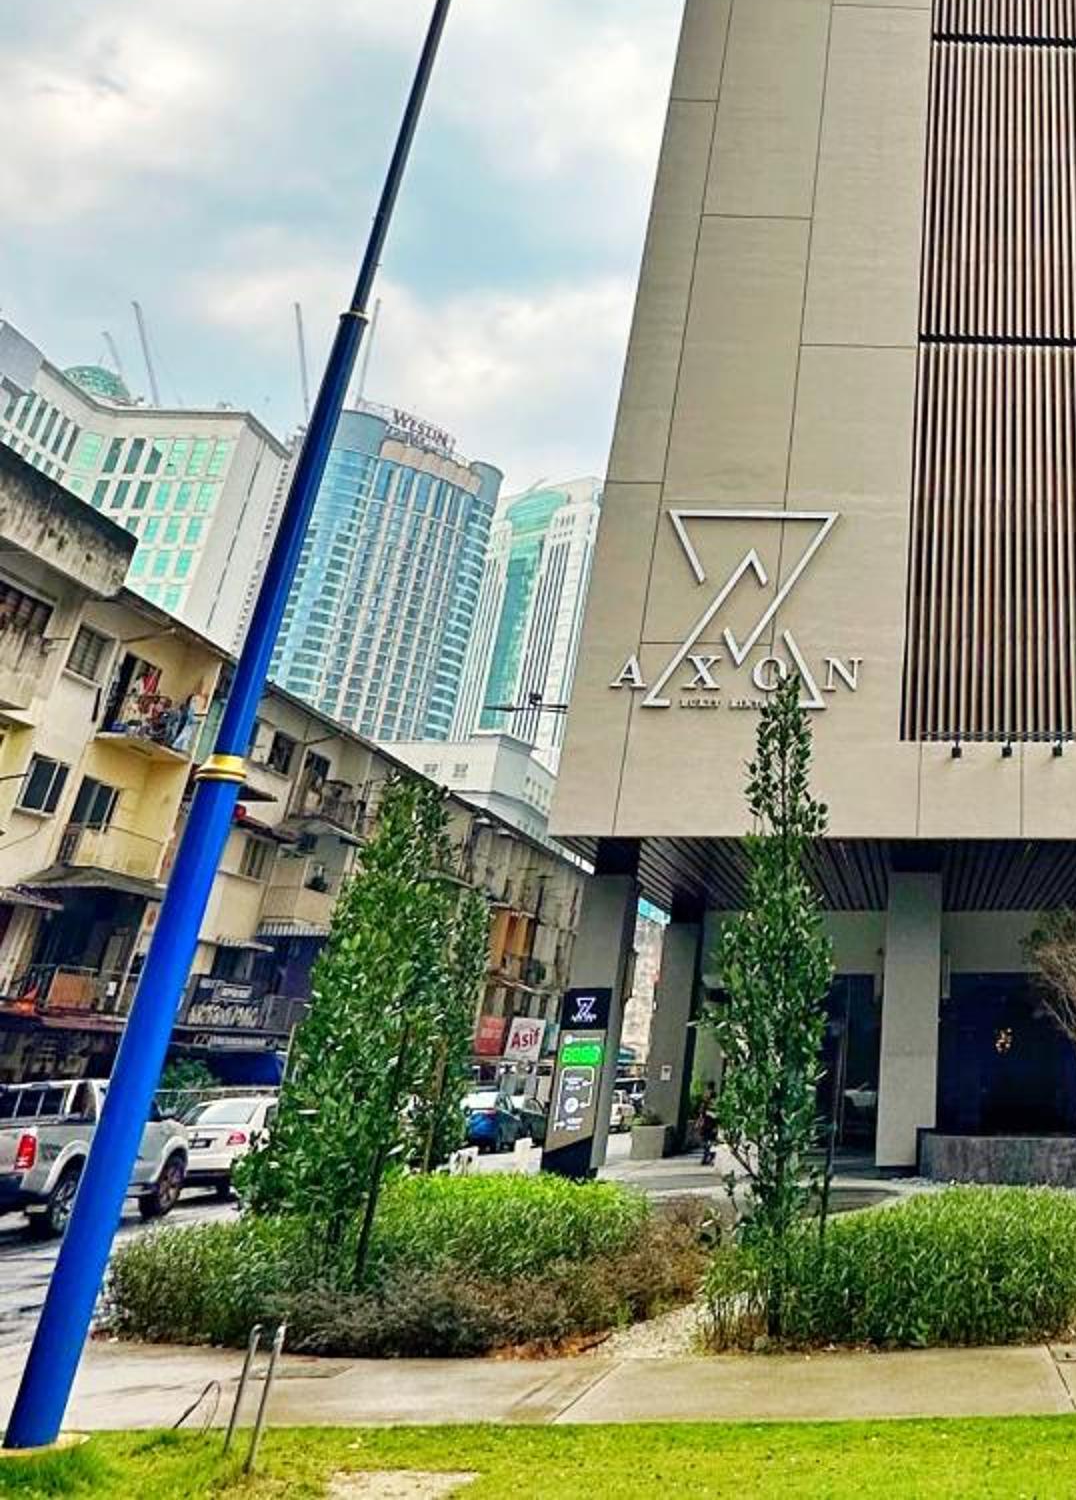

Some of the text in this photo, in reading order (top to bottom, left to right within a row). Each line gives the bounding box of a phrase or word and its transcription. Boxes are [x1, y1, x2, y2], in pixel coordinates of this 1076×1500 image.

[393, 408, 449, 448] WESTIN
[609, 653, 863, 692] AXON
[511, 1027, 541, 1050] Asif
